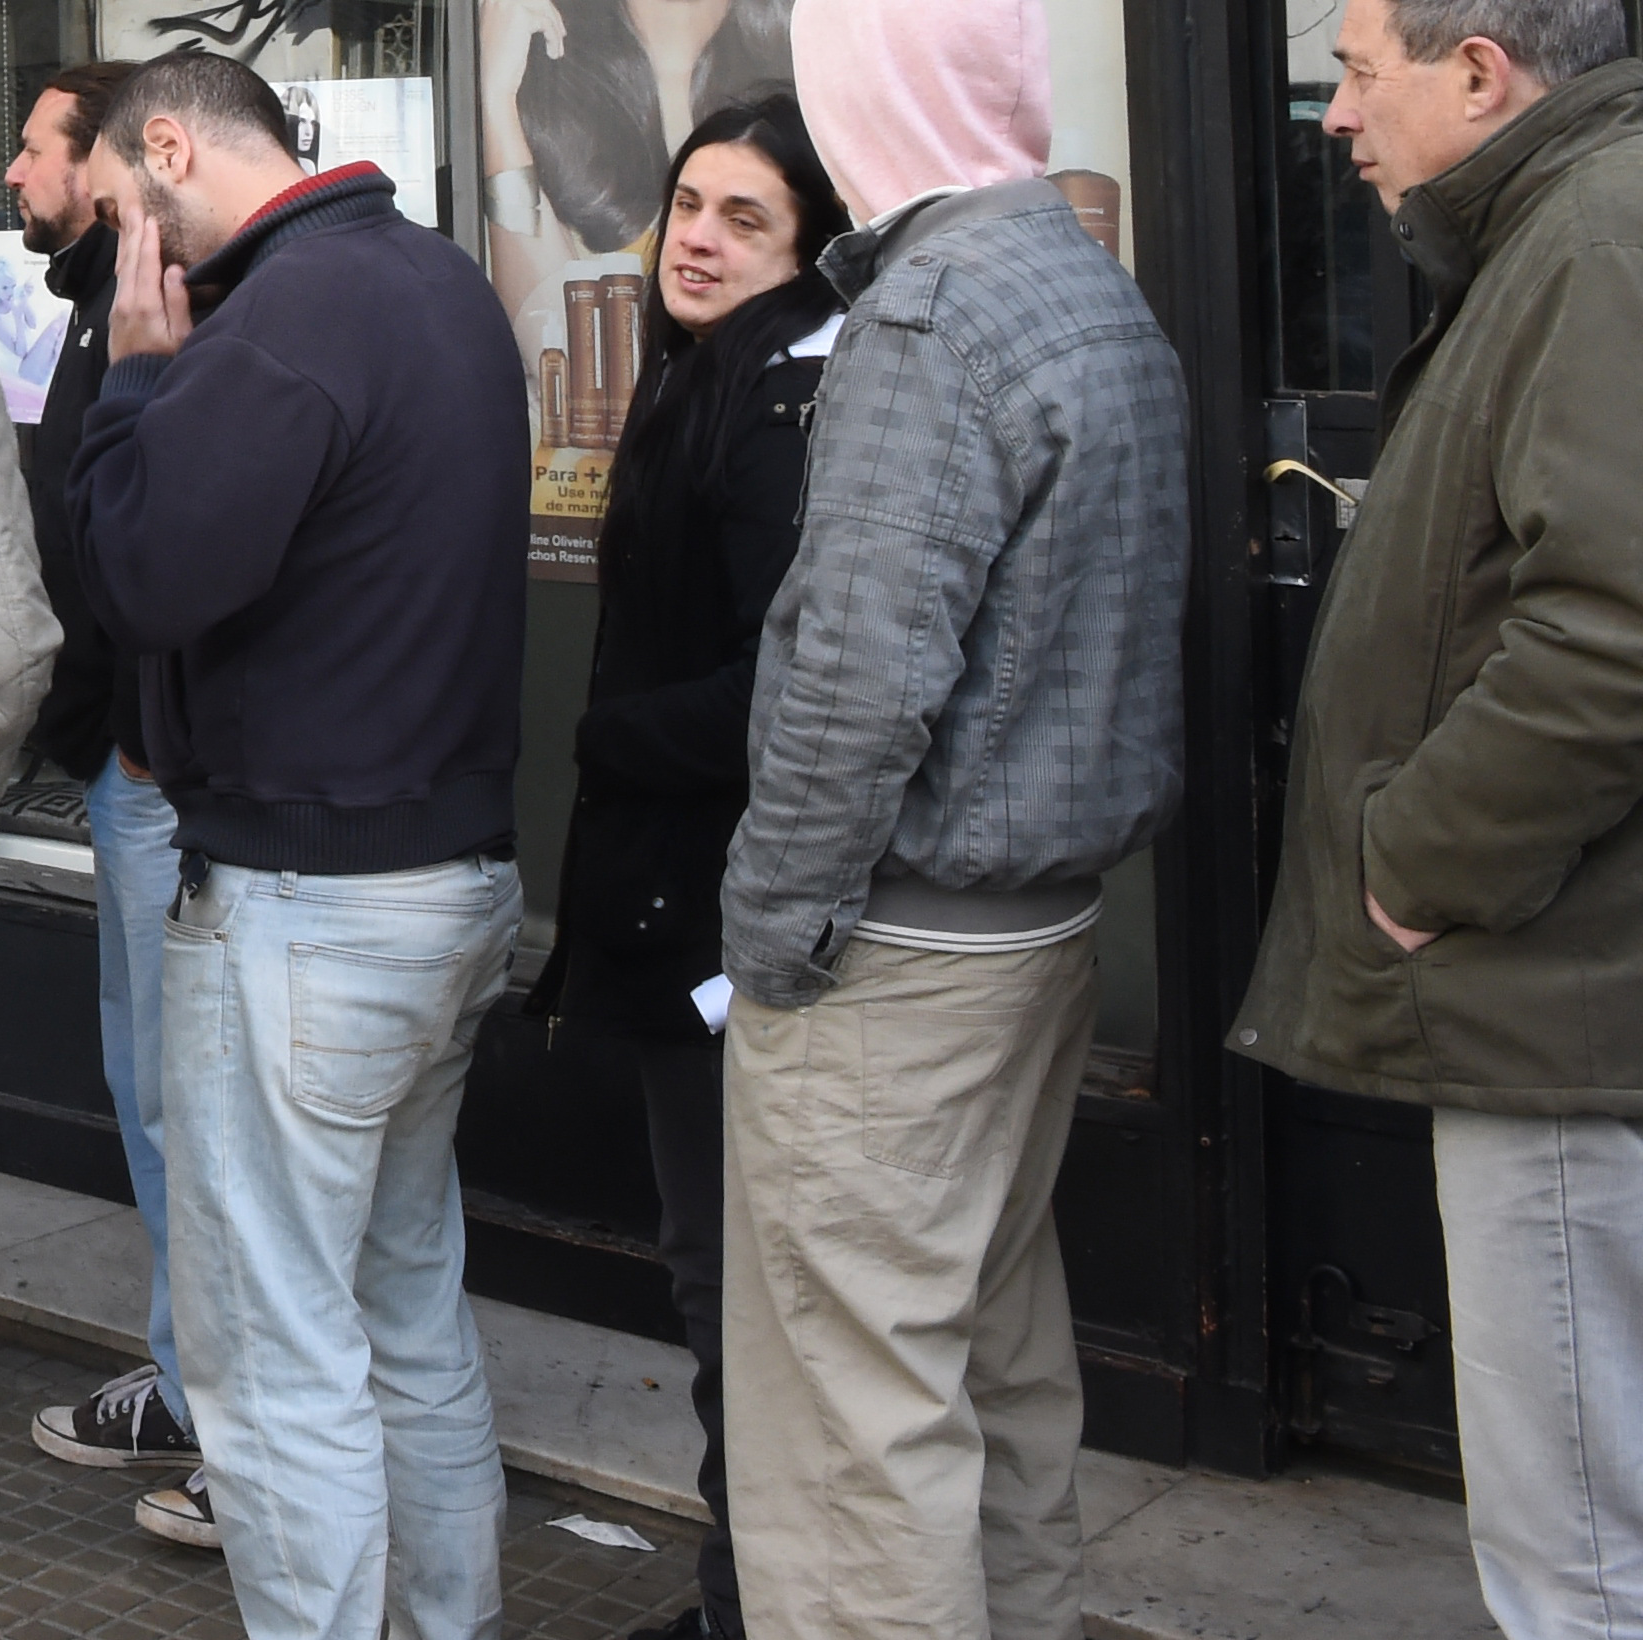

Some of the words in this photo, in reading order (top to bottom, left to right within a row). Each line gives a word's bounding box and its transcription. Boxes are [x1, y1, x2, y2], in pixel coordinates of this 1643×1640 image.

[535, 465, 578, 482] Para
[557, 485, 586, 499] Use
[545, 499, 564, 512] de
[551, 534, 594, 549] Oliveira
